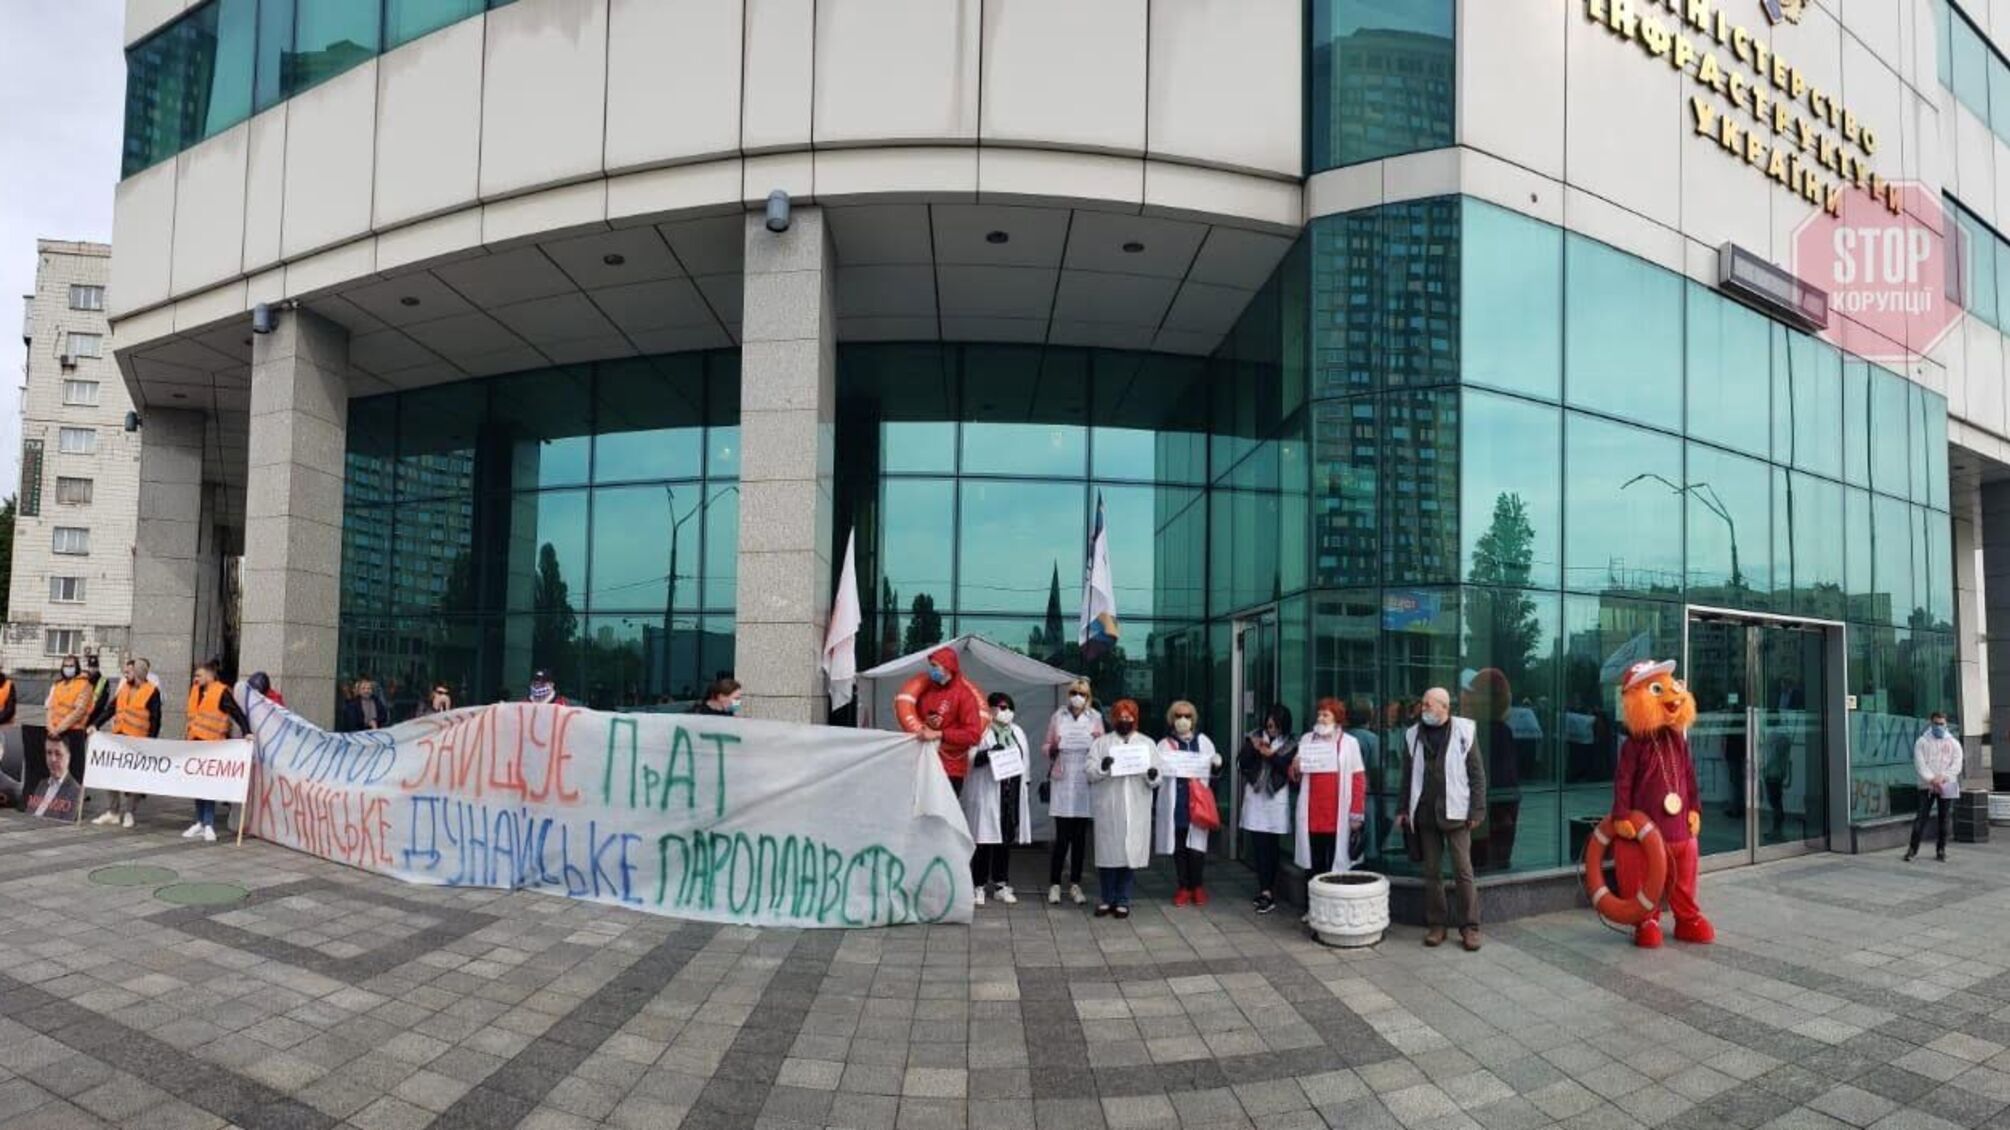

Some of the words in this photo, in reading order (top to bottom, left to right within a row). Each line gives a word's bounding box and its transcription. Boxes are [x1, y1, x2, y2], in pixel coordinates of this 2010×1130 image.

[1585, 0, 1900, 216] ІНФРАСТРУКТУРИ
[1647, 0, 1879, 155] НІСТЕРСТВО
[1690, 95, 1840, 219] УКРАЇНИ
[90, 749, 172, 774] МІНЯЙЛО
[183, 757, 245, 780] СХЕМИ
[603, 717, 742, 818] ПрАТ
[249, 767, 394, 867] КРАЇНСЬКЕ
[402, 795, 644, 905] ДУНАЙСЬКЕ
[655, 830, 956, 925] ПАРОПЛАВСТВО
